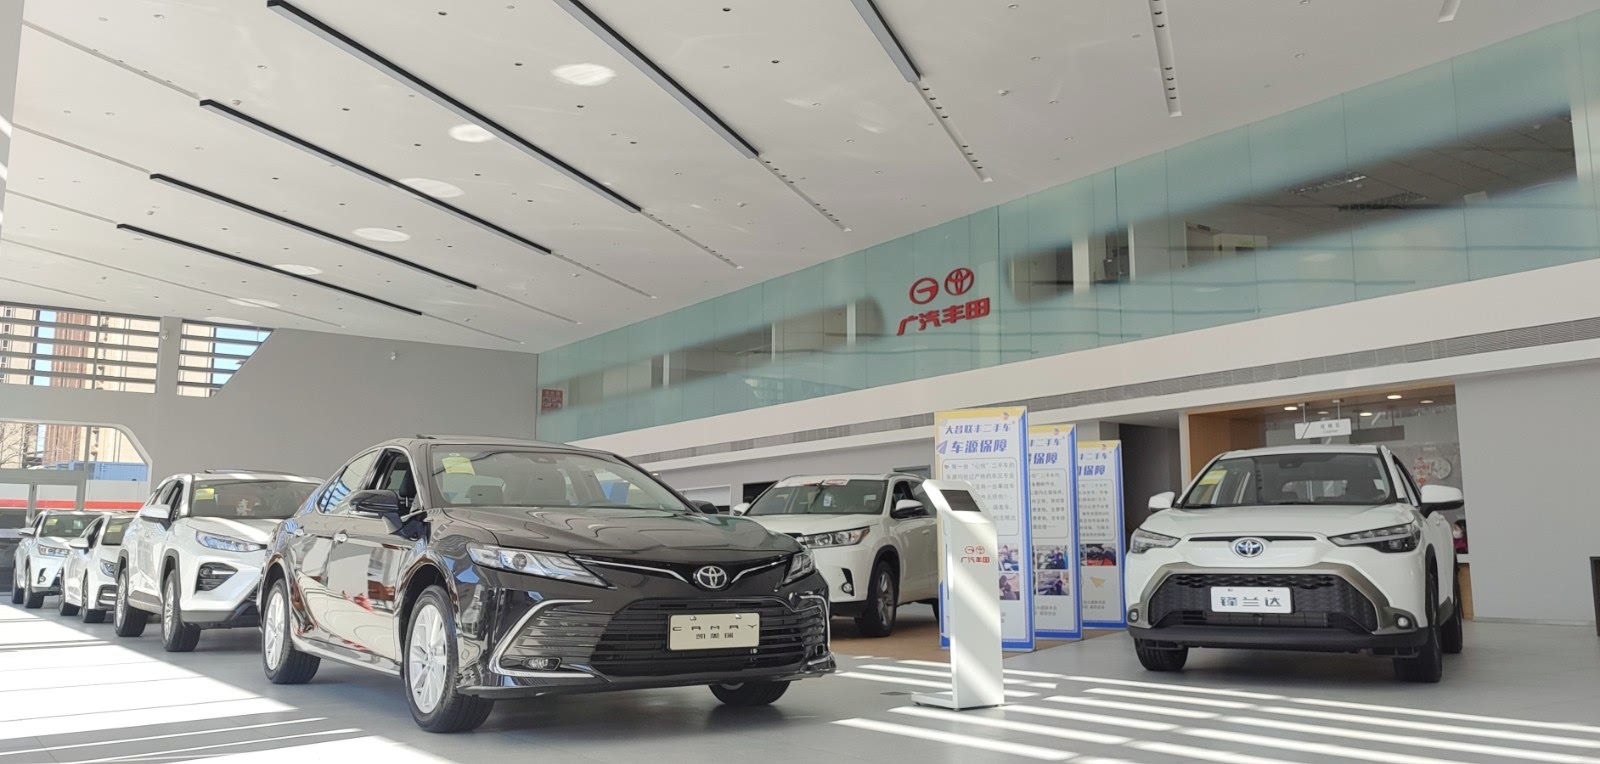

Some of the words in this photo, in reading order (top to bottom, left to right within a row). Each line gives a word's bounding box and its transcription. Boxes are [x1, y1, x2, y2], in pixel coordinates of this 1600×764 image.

[896, 297, 990, 336] 广汽丰田
[950, 439, 1007, 454] 车源保障
[1220, 596, 1282, 607] 锋兰达
[672, 624, 757, 632] CAMRY
